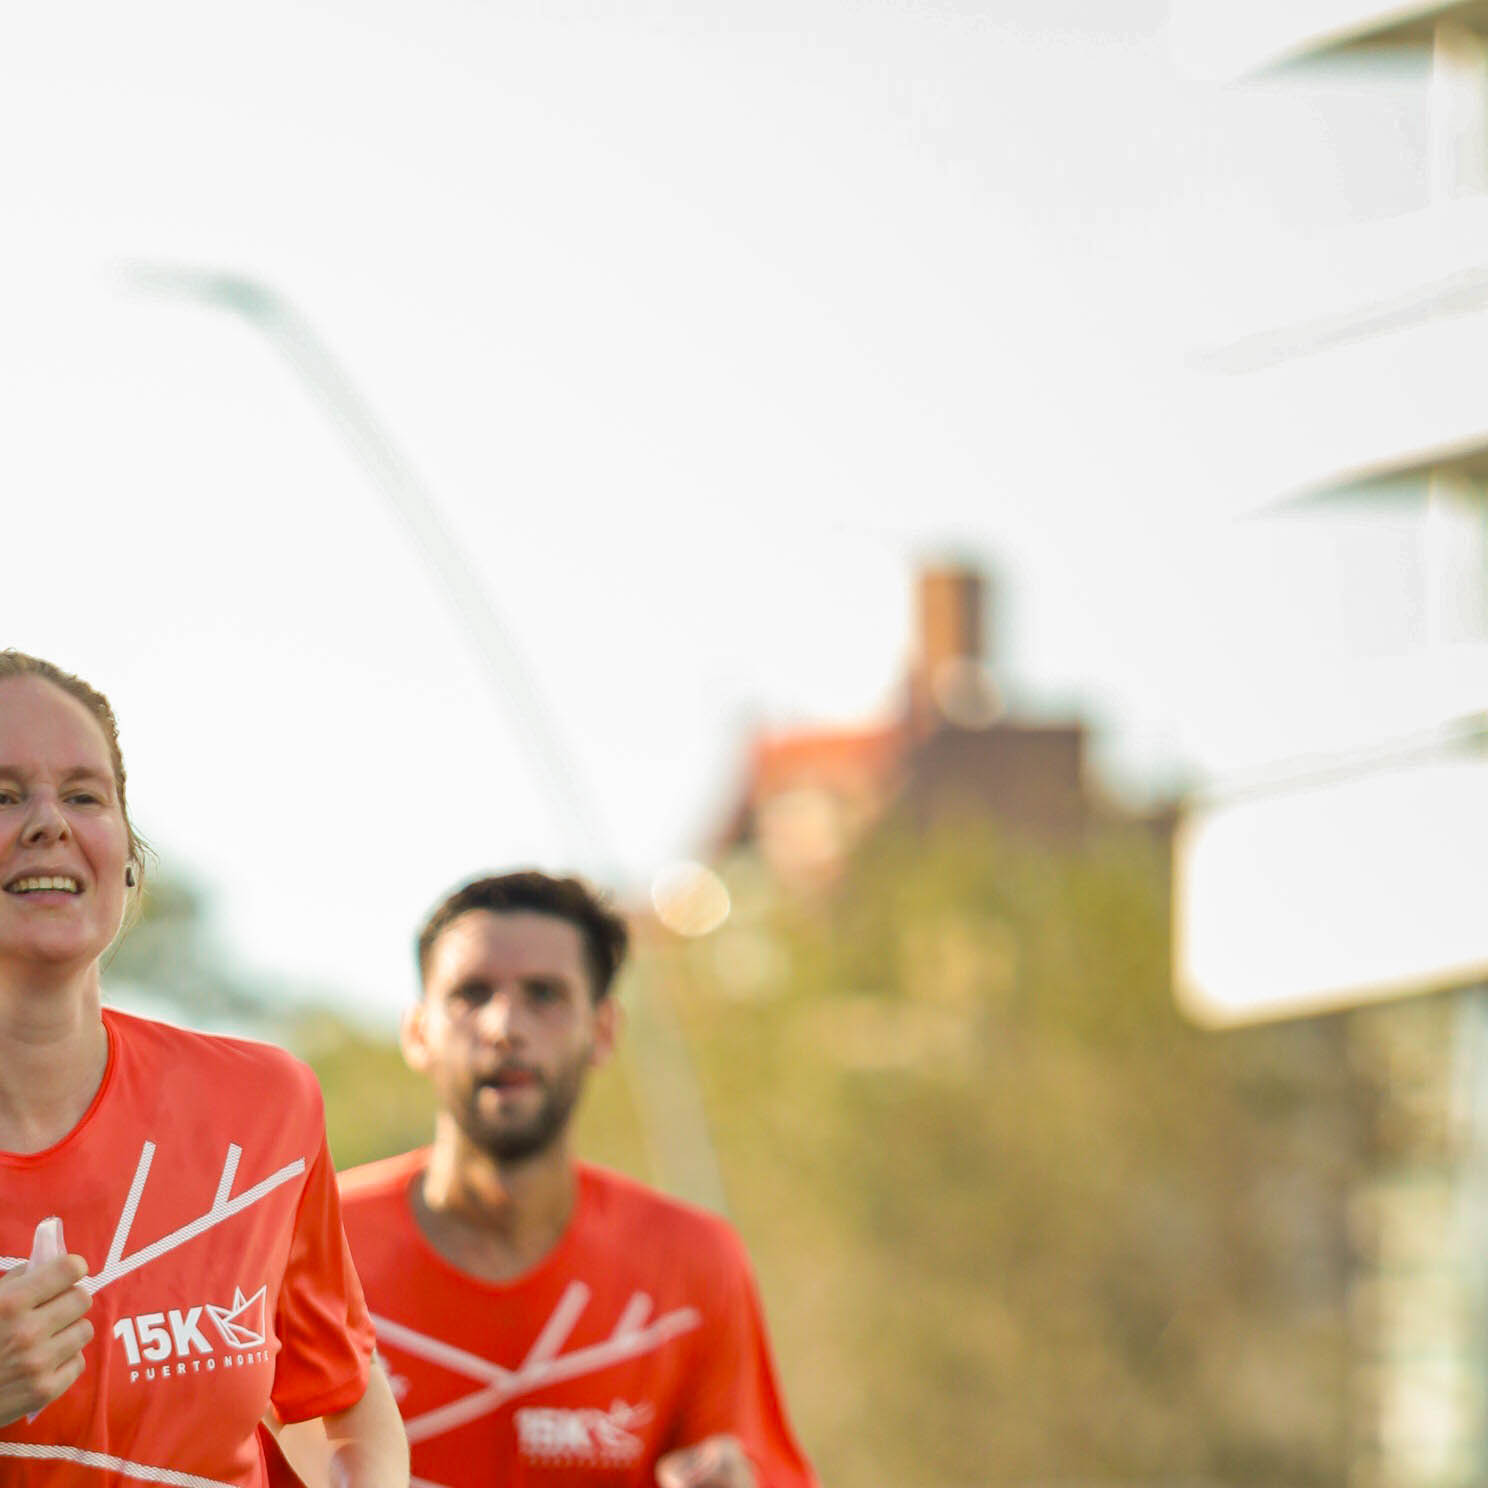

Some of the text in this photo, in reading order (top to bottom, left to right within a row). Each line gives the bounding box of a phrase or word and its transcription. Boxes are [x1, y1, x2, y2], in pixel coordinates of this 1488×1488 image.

[113, 1306, 214, 1365] 15K
[130, 1350, 269, 1383] PUERTO NORTE
